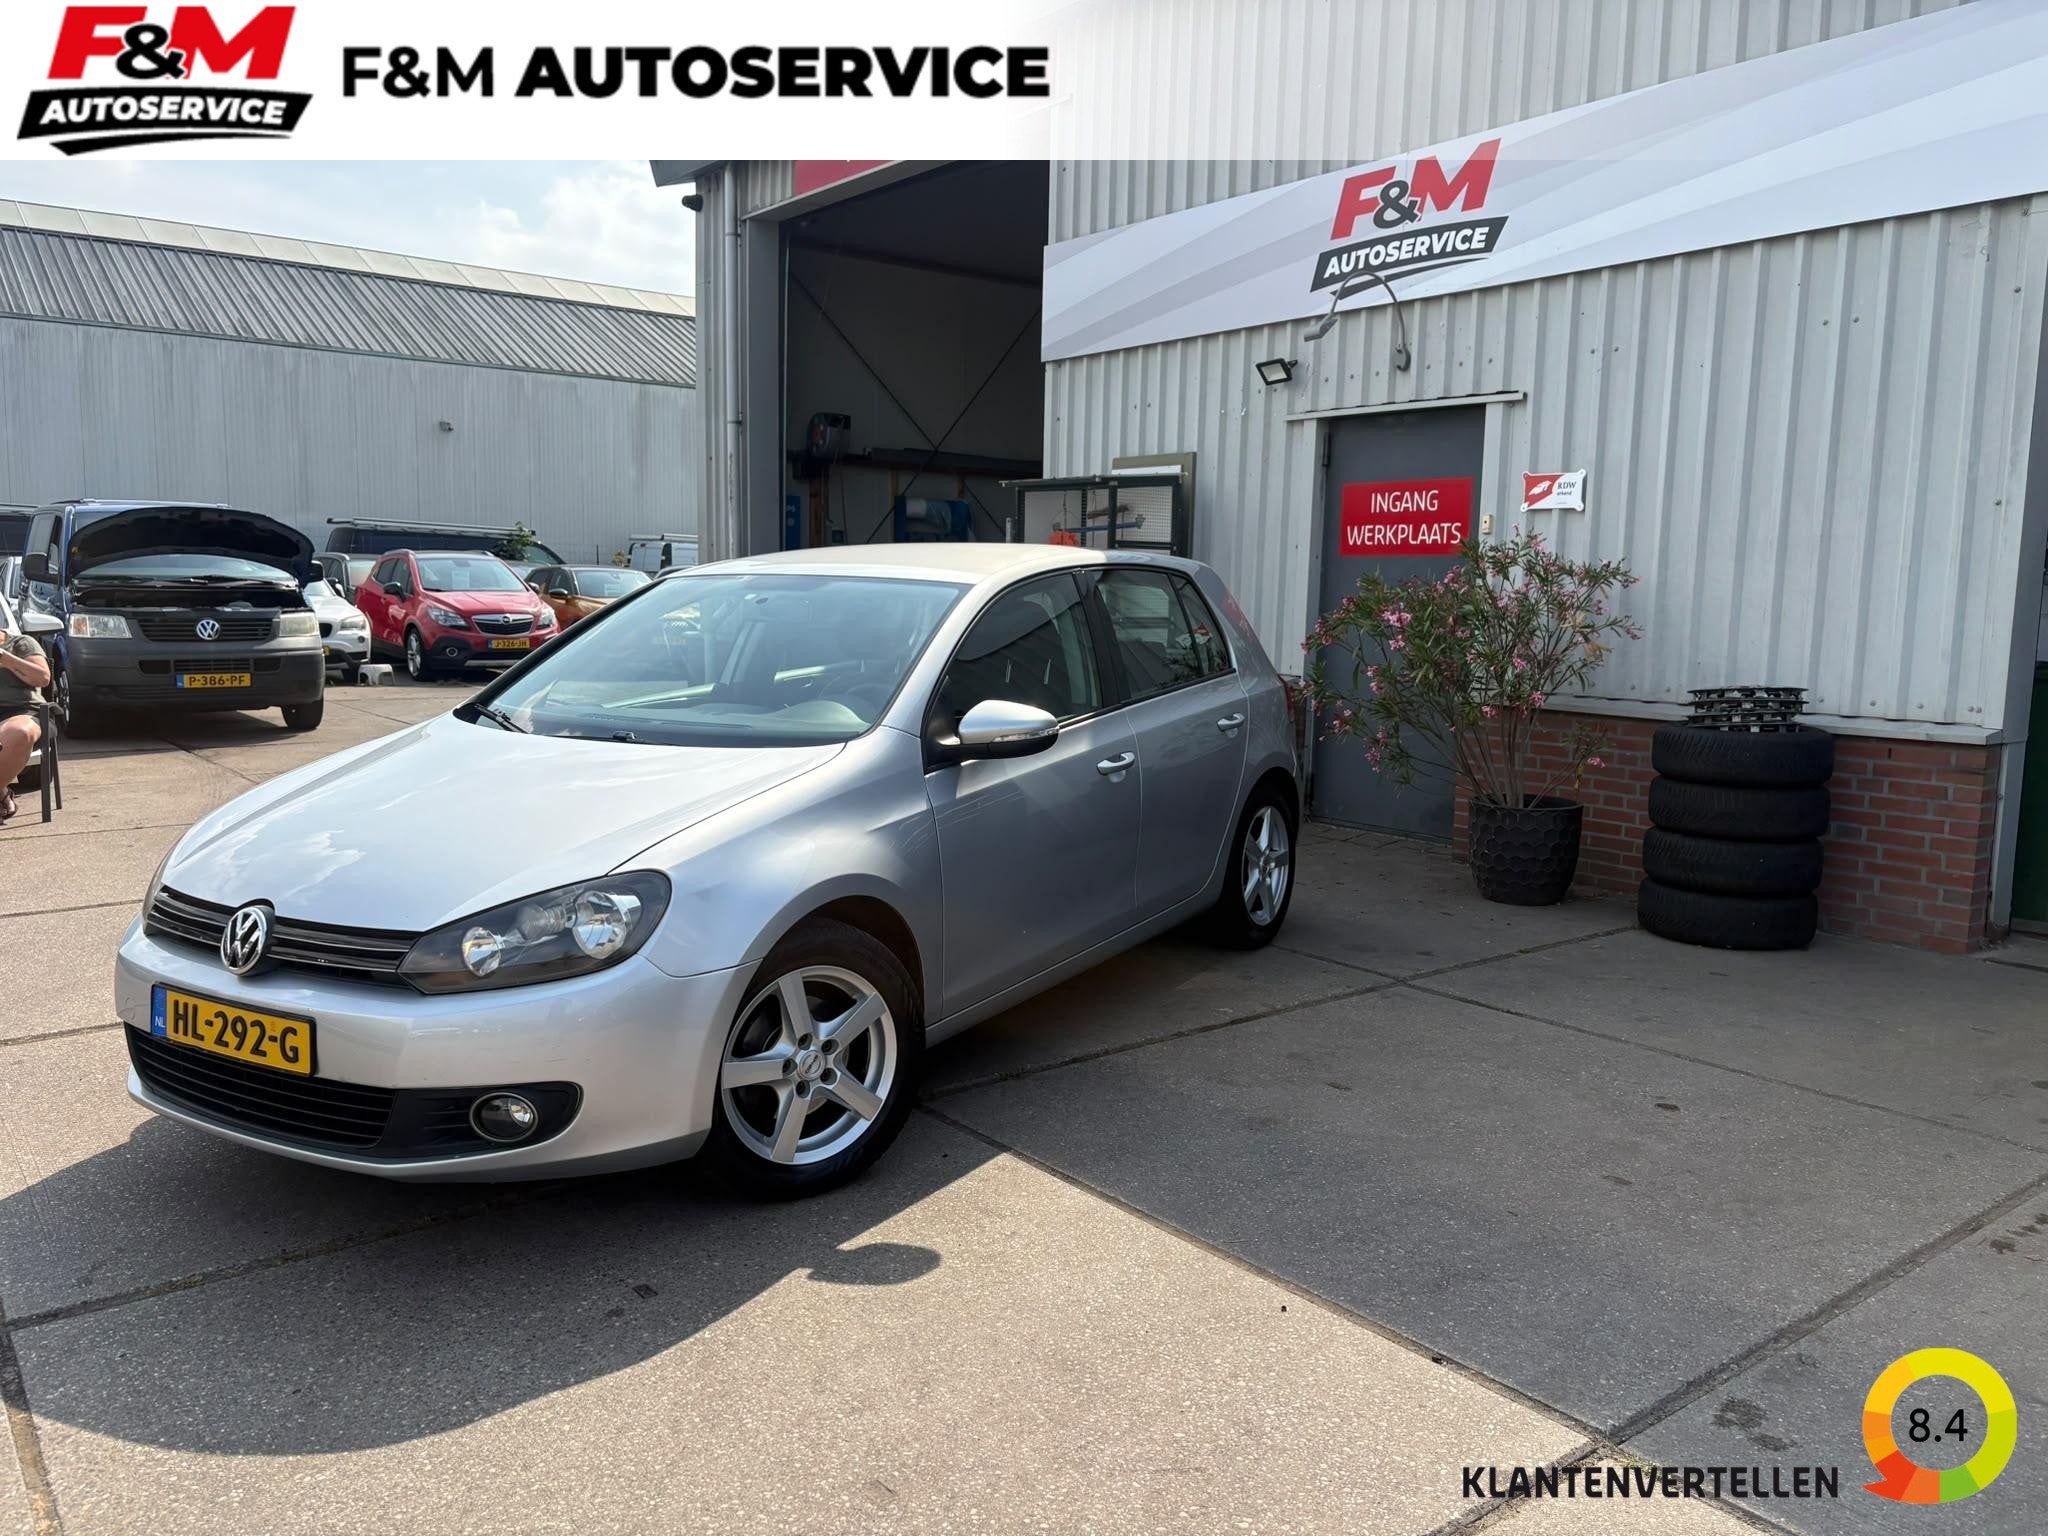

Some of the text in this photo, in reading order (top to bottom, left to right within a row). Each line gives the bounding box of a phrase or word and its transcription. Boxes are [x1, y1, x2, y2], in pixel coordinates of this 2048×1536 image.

[1330, 138, 1501, 240] F&M
[1323, 227, 1489, 279] AUTOSERVICE
[1370, 490, 1439, 513] INGANG
[1346, 523, 1462, 546] WERKPLAATS
[188, 675, 246, 686] P-386-PF
[154, 1015, 166, 1028] NL
[173, 999, 300, 1064] HL-292-G
